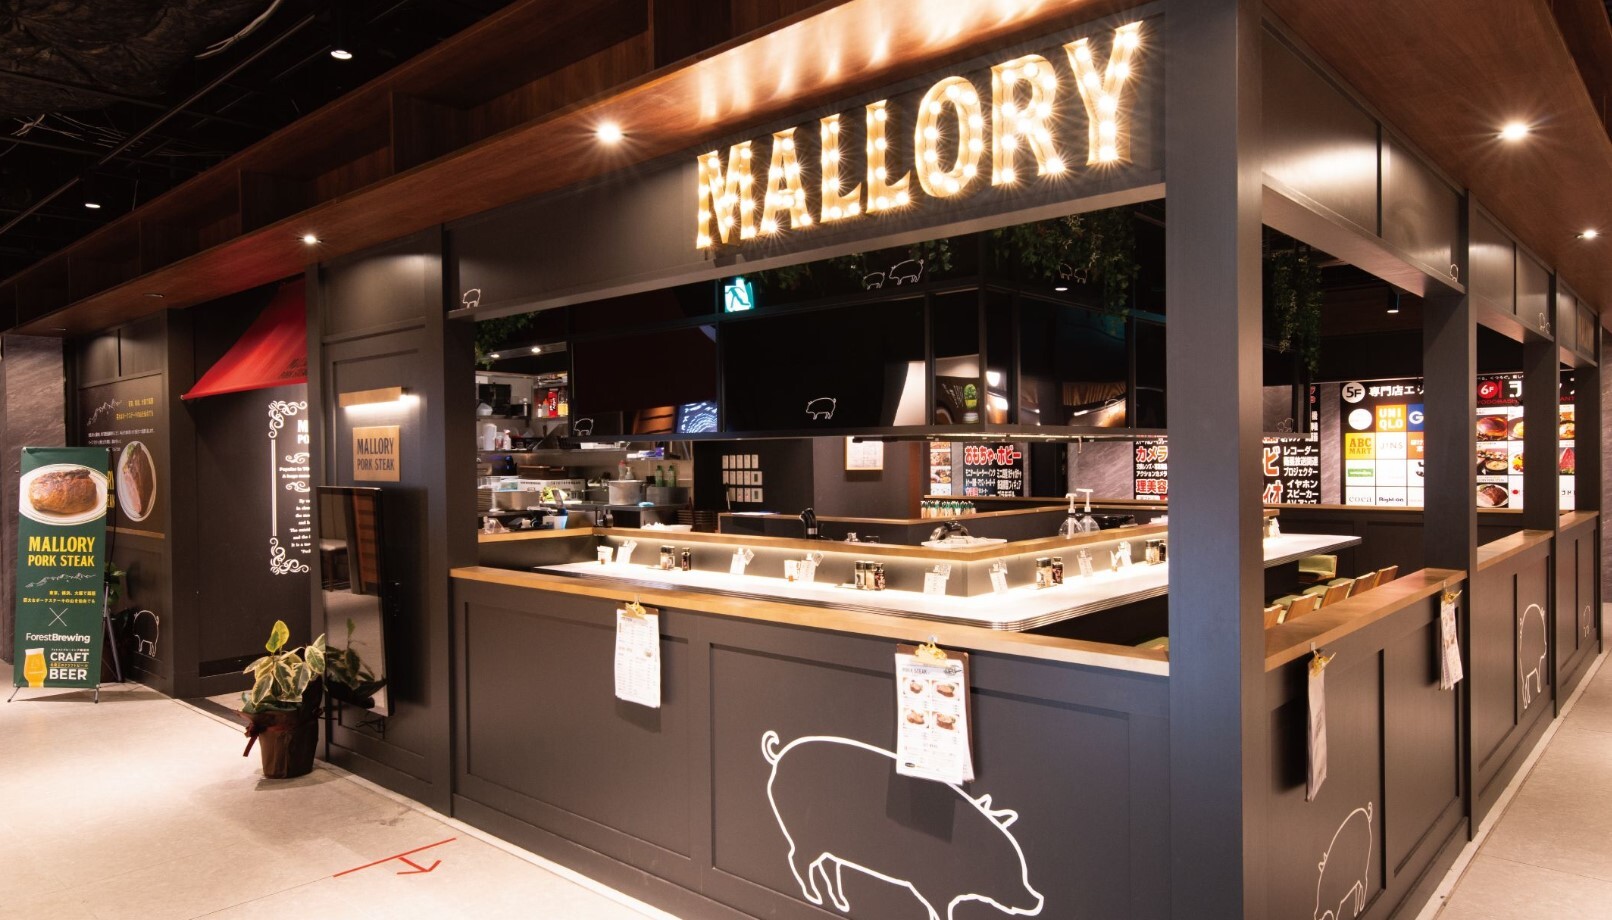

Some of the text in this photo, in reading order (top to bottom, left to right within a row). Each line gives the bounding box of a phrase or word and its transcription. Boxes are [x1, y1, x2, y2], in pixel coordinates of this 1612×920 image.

[696, 20, 1144, 249] MALLORY
[1346, 386, 1362, 398] 5F
[1480, 385, 1495, 395] 6F
[1379, 408, 1402, 418] UNI
[1379, 419, 1404, 431] QLO
[357, 438, 394, 455] MALLORY
[1349, 438, 1372, 448] ABC
[965, 445, 1022, 466] おもちゃ・ホビー
[1136, 446, 1168, 463] カメラ
[1283, 446, 1319, 455] レコーダー
[357, 458, 395, 471] PORK STEAK
[1283, 467, 1319, 477] プロジェクター
[1136, 479, 1168, 494] 理美容
[1287, 480, 1318, 489] イヤホン
[1287, 490, 1319, 499] スピーカー
[28, 536, 95, 553] MALLORY
[28, 555, 95, 567] PORK STEAK
[25, 633, 91, 644] ForestBrewing
[50, 652, 89, 662] CRAFT
[49, 669, 87, 680] BEER
